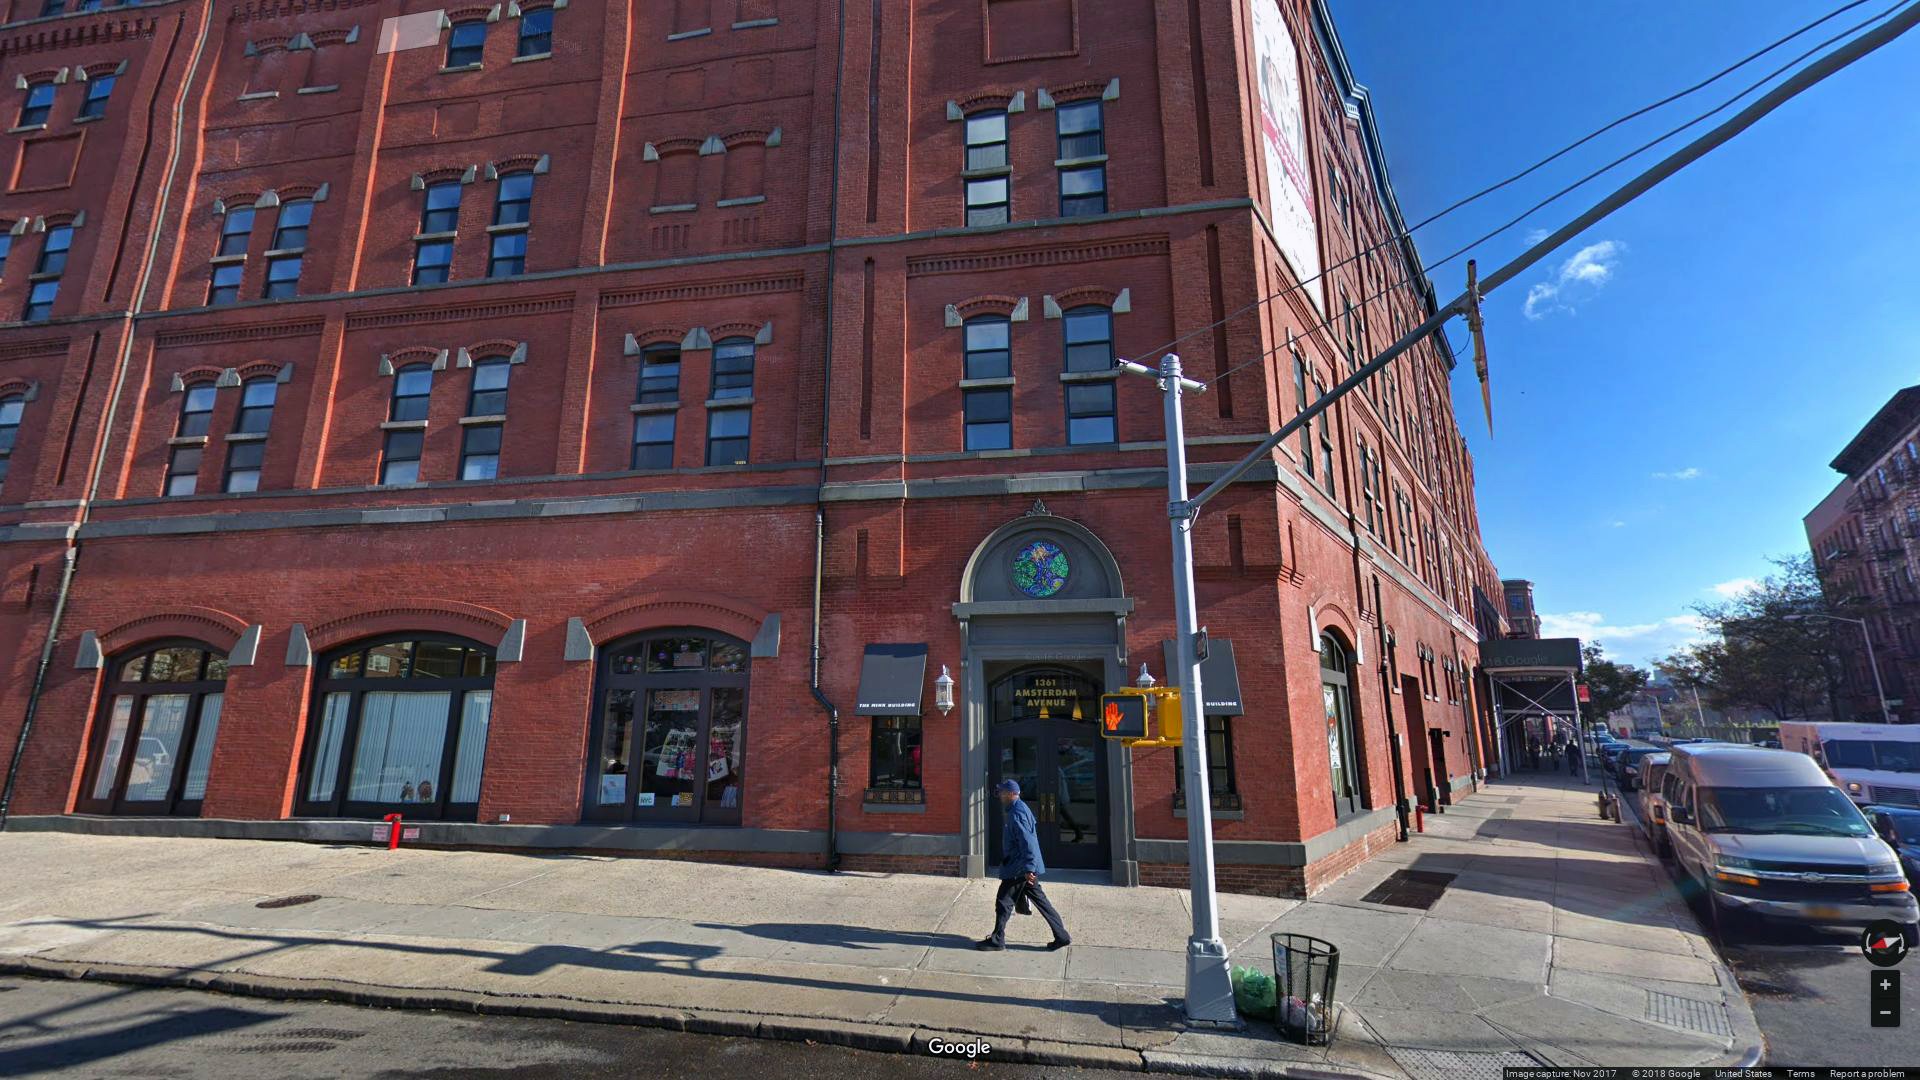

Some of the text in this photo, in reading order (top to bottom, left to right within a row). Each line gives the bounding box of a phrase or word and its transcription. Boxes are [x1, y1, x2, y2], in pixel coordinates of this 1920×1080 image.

[1035, 678, 1057, 687] 1361
[1015, 688, 1077, 697] AMSTERDAM
[1027, 698, 1067, 707] AVENUE
